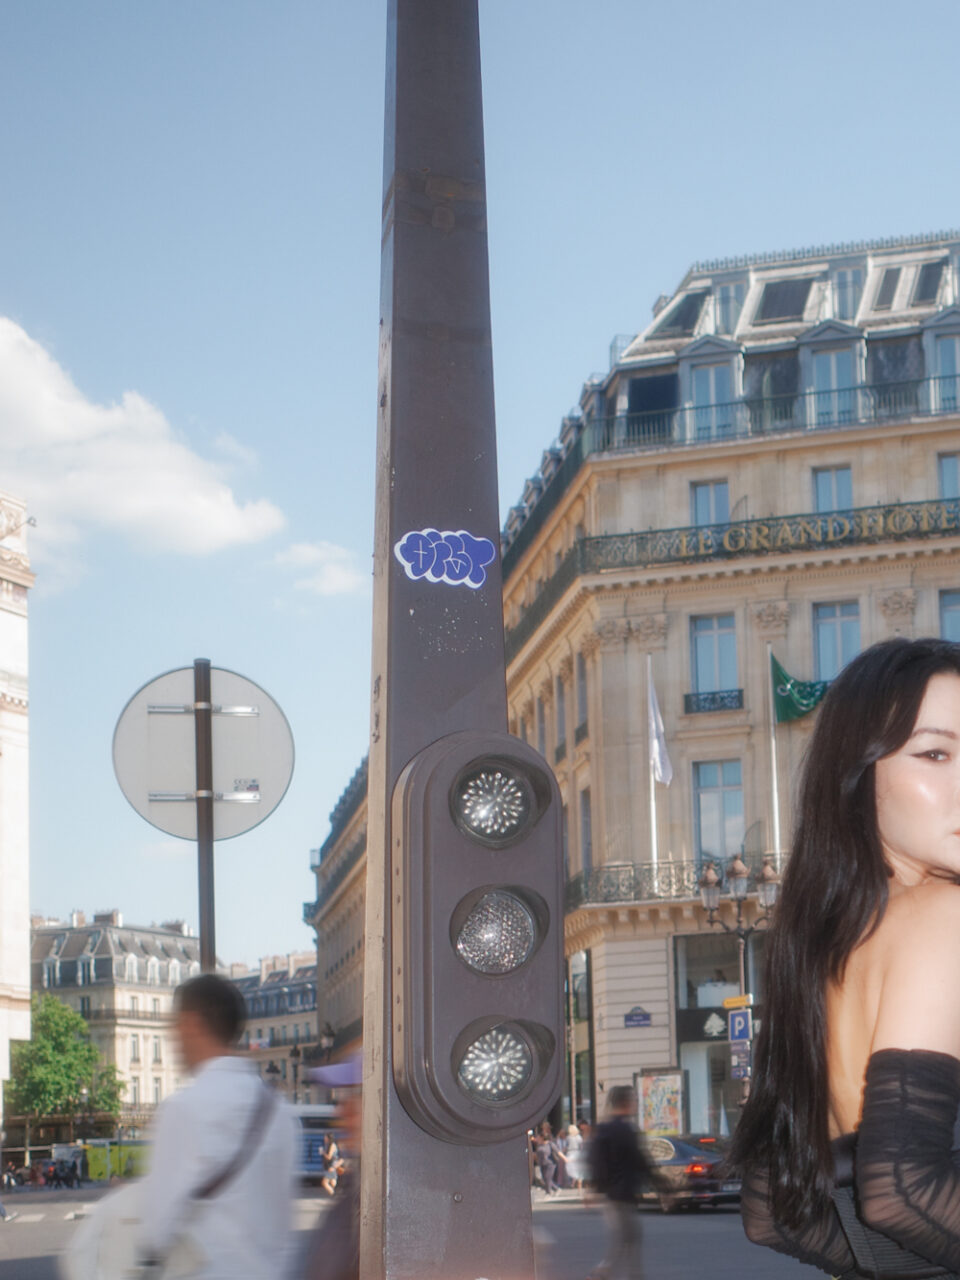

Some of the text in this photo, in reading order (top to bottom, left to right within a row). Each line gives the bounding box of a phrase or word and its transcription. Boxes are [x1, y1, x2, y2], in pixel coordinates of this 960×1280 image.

[679, 530, 713, 557] LE
[722, 518, 850, 551] GRAND
[735, 1016, 745, 1036] P
